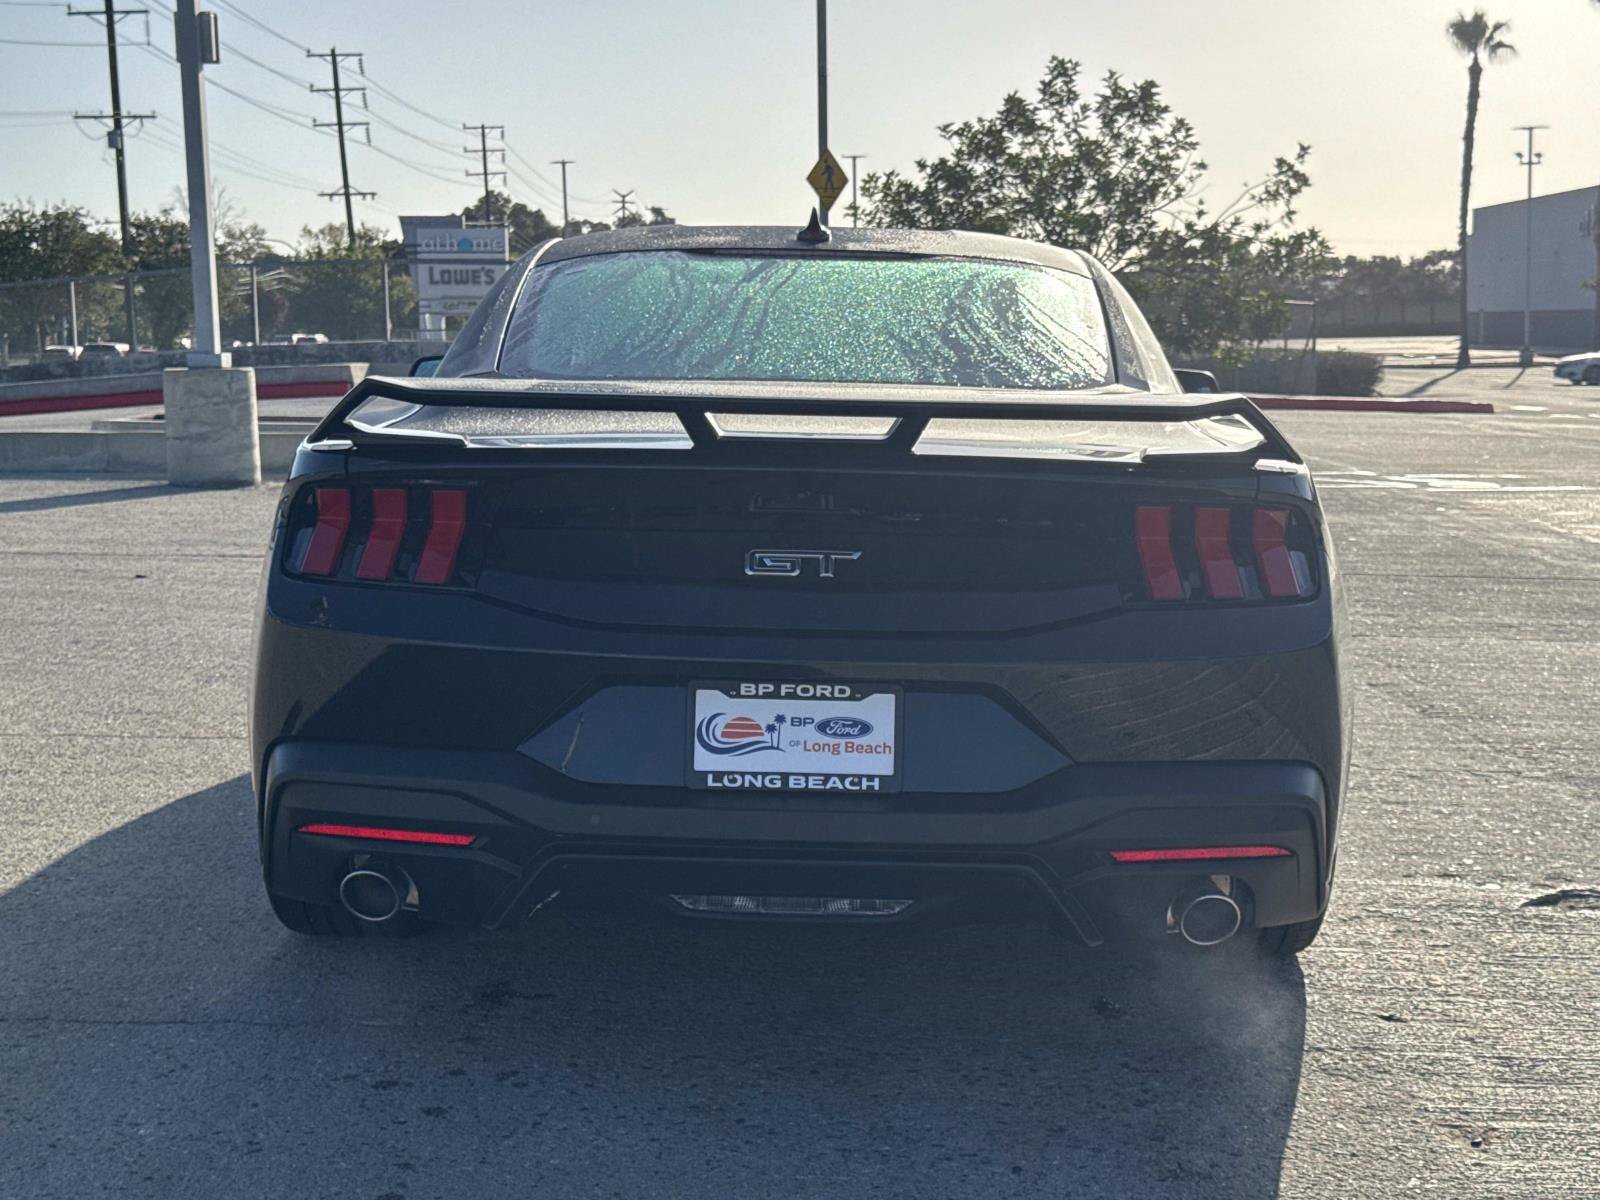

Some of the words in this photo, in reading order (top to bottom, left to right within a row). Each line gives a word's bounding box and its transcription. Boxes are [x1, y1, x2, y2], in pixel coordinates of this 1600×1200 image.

[744, 549, 863, 577] GT
[740, 684, 774, 696] BP
[780, 684, 851, 698] FORD
[790, 716, 815, 727] BP
[826, 720, 861, 736] Ford
[789, 739, 800, 748] OF
[803, 739, 840, 755] Long
[845, 740, 892, 755] Beach
[707, 773, 781, 789] LONG
[788, 775, 880, 791] BEACH
